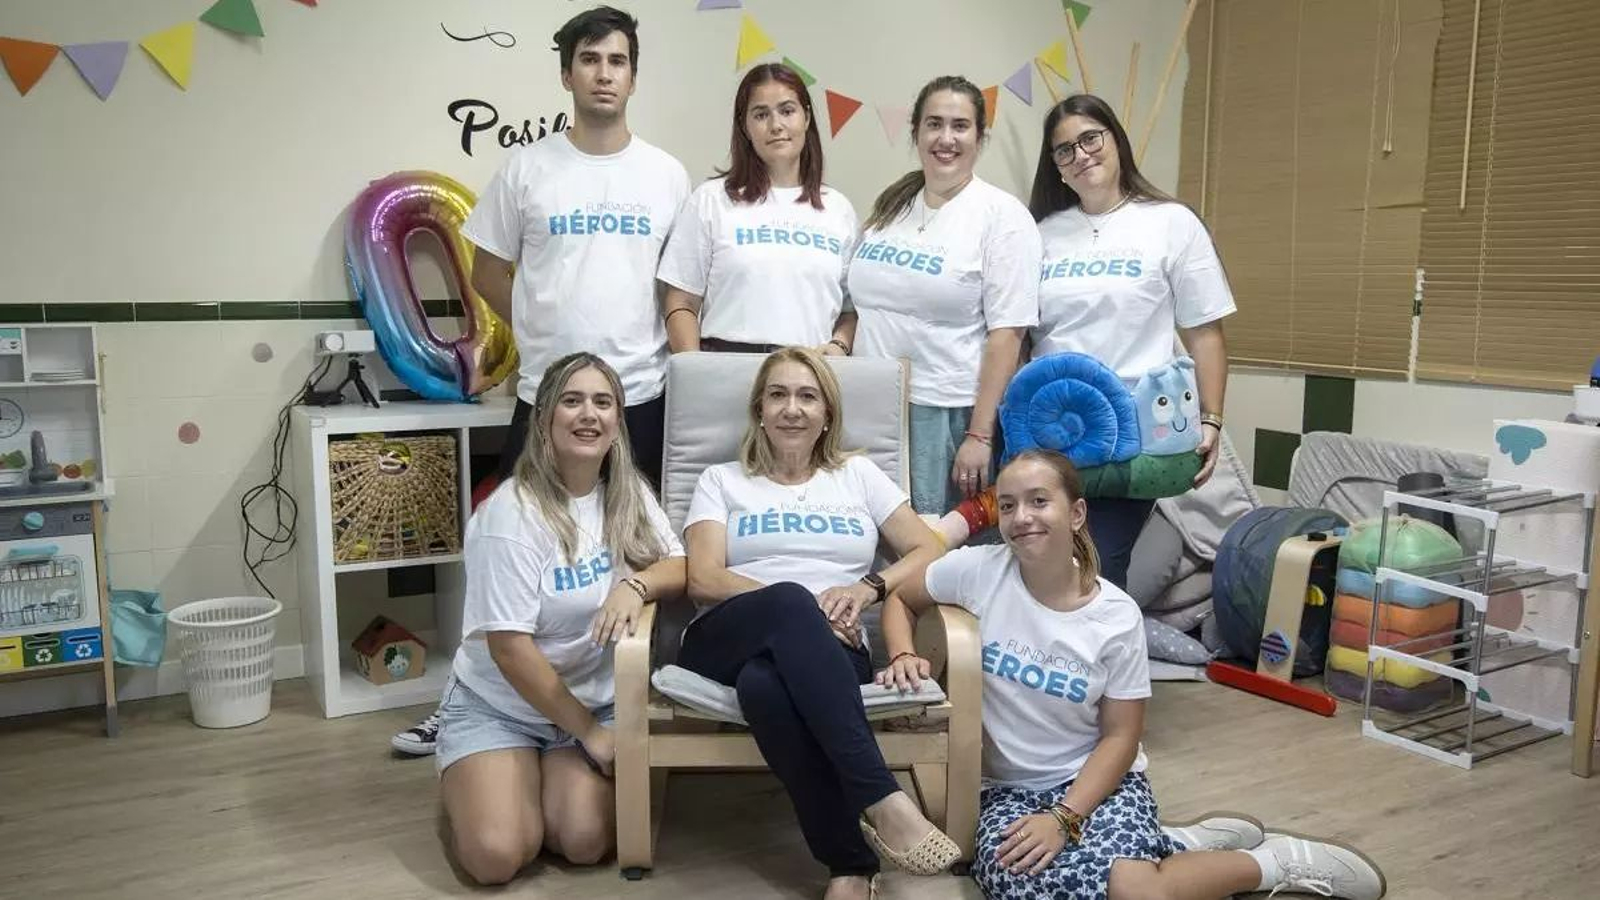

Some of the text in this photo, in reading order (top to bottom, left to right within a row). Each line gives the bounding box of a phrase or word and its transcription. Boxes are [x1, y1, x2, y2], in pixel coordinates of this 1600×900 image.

[549, 208, 652, 236] HÉROES
[736, 224, 841, 256] HÉROES
[856, 240, 945, 276] HÉROES
[736, 507, 865, 537] HÉROES
